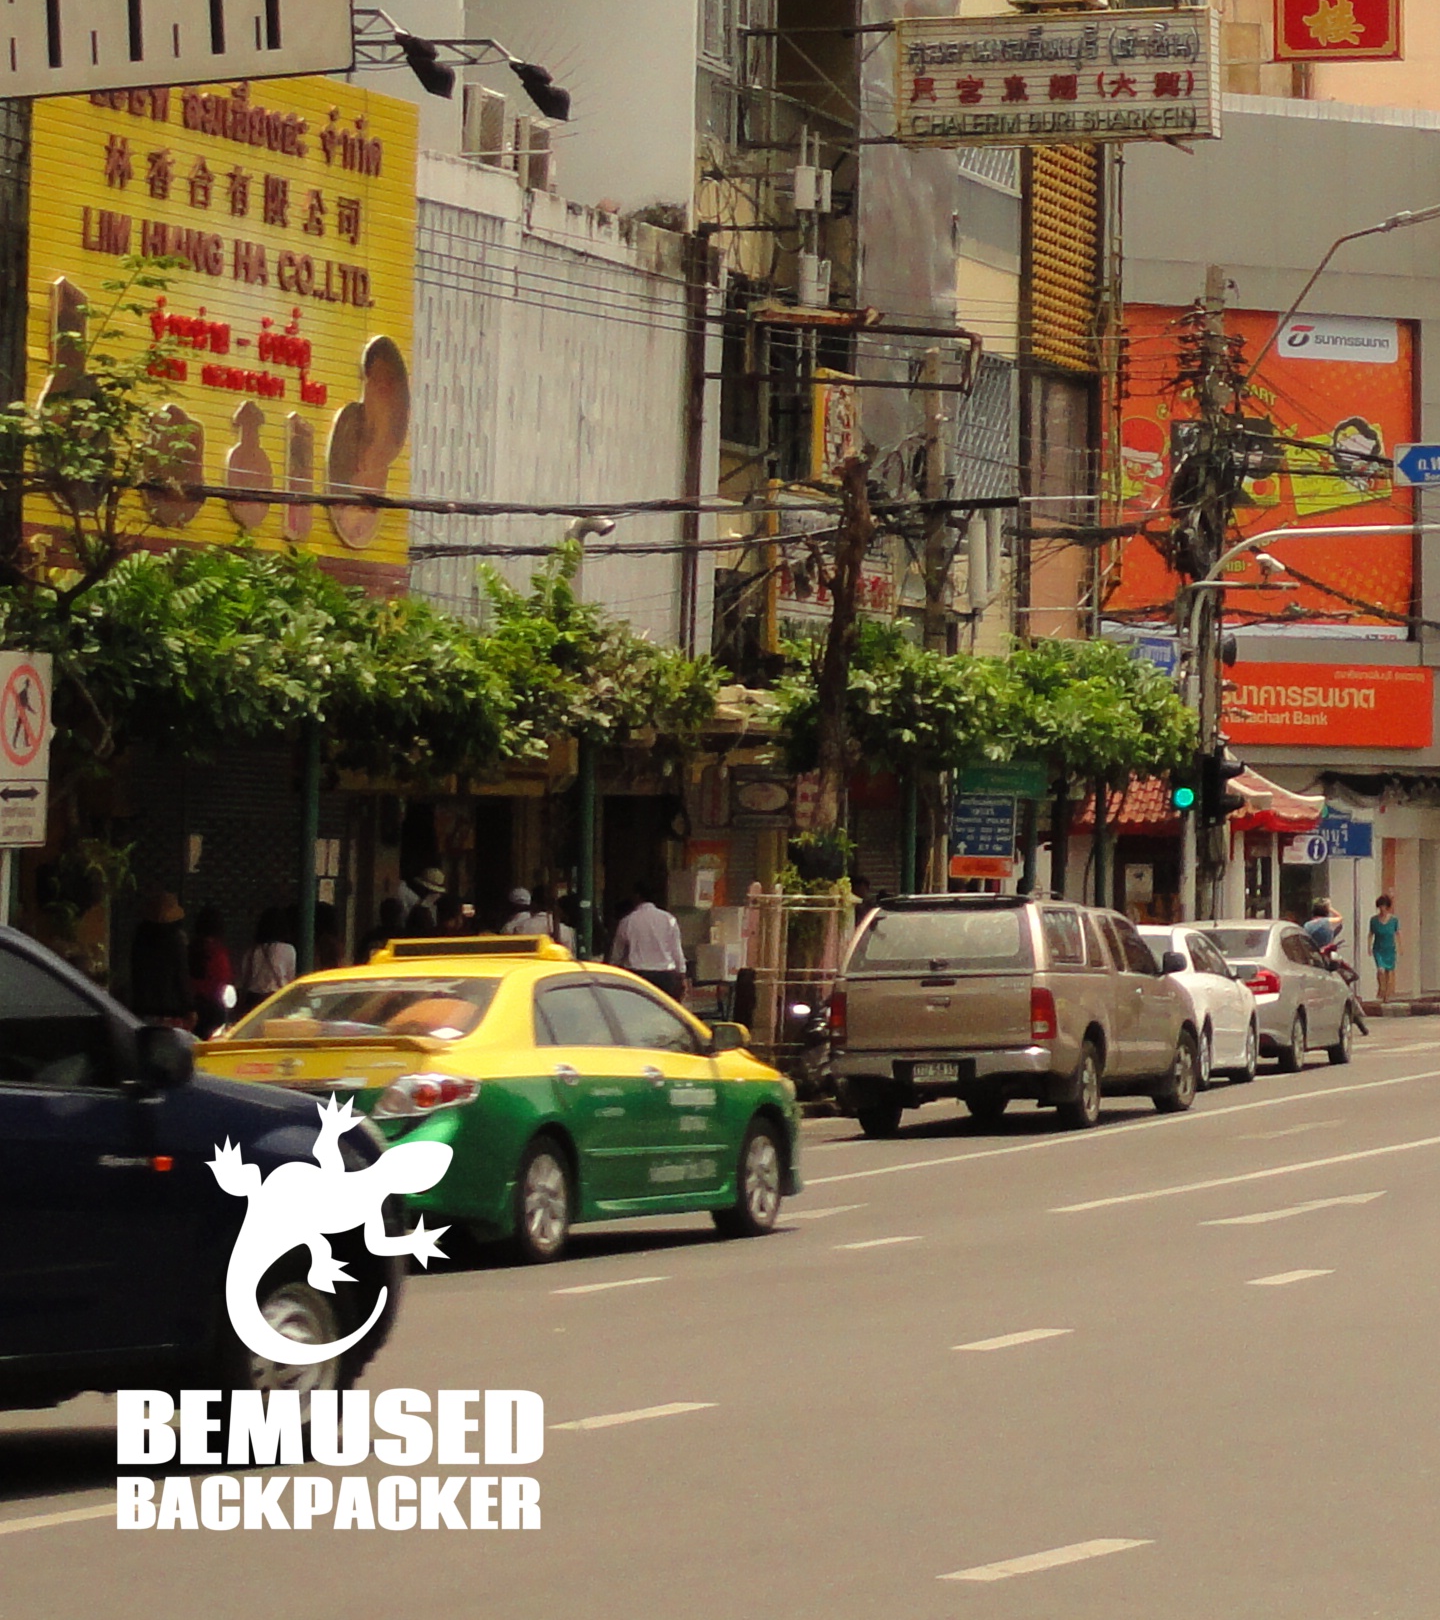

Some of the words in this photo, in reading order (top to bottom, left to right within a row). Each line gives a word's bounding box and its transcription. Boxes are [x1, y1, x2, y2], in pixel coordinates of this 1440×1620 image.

[81, 206, 132, 256] LIM
[233, 238, 270, 286] HA
[1293, 711, 1328, 725] Bank
